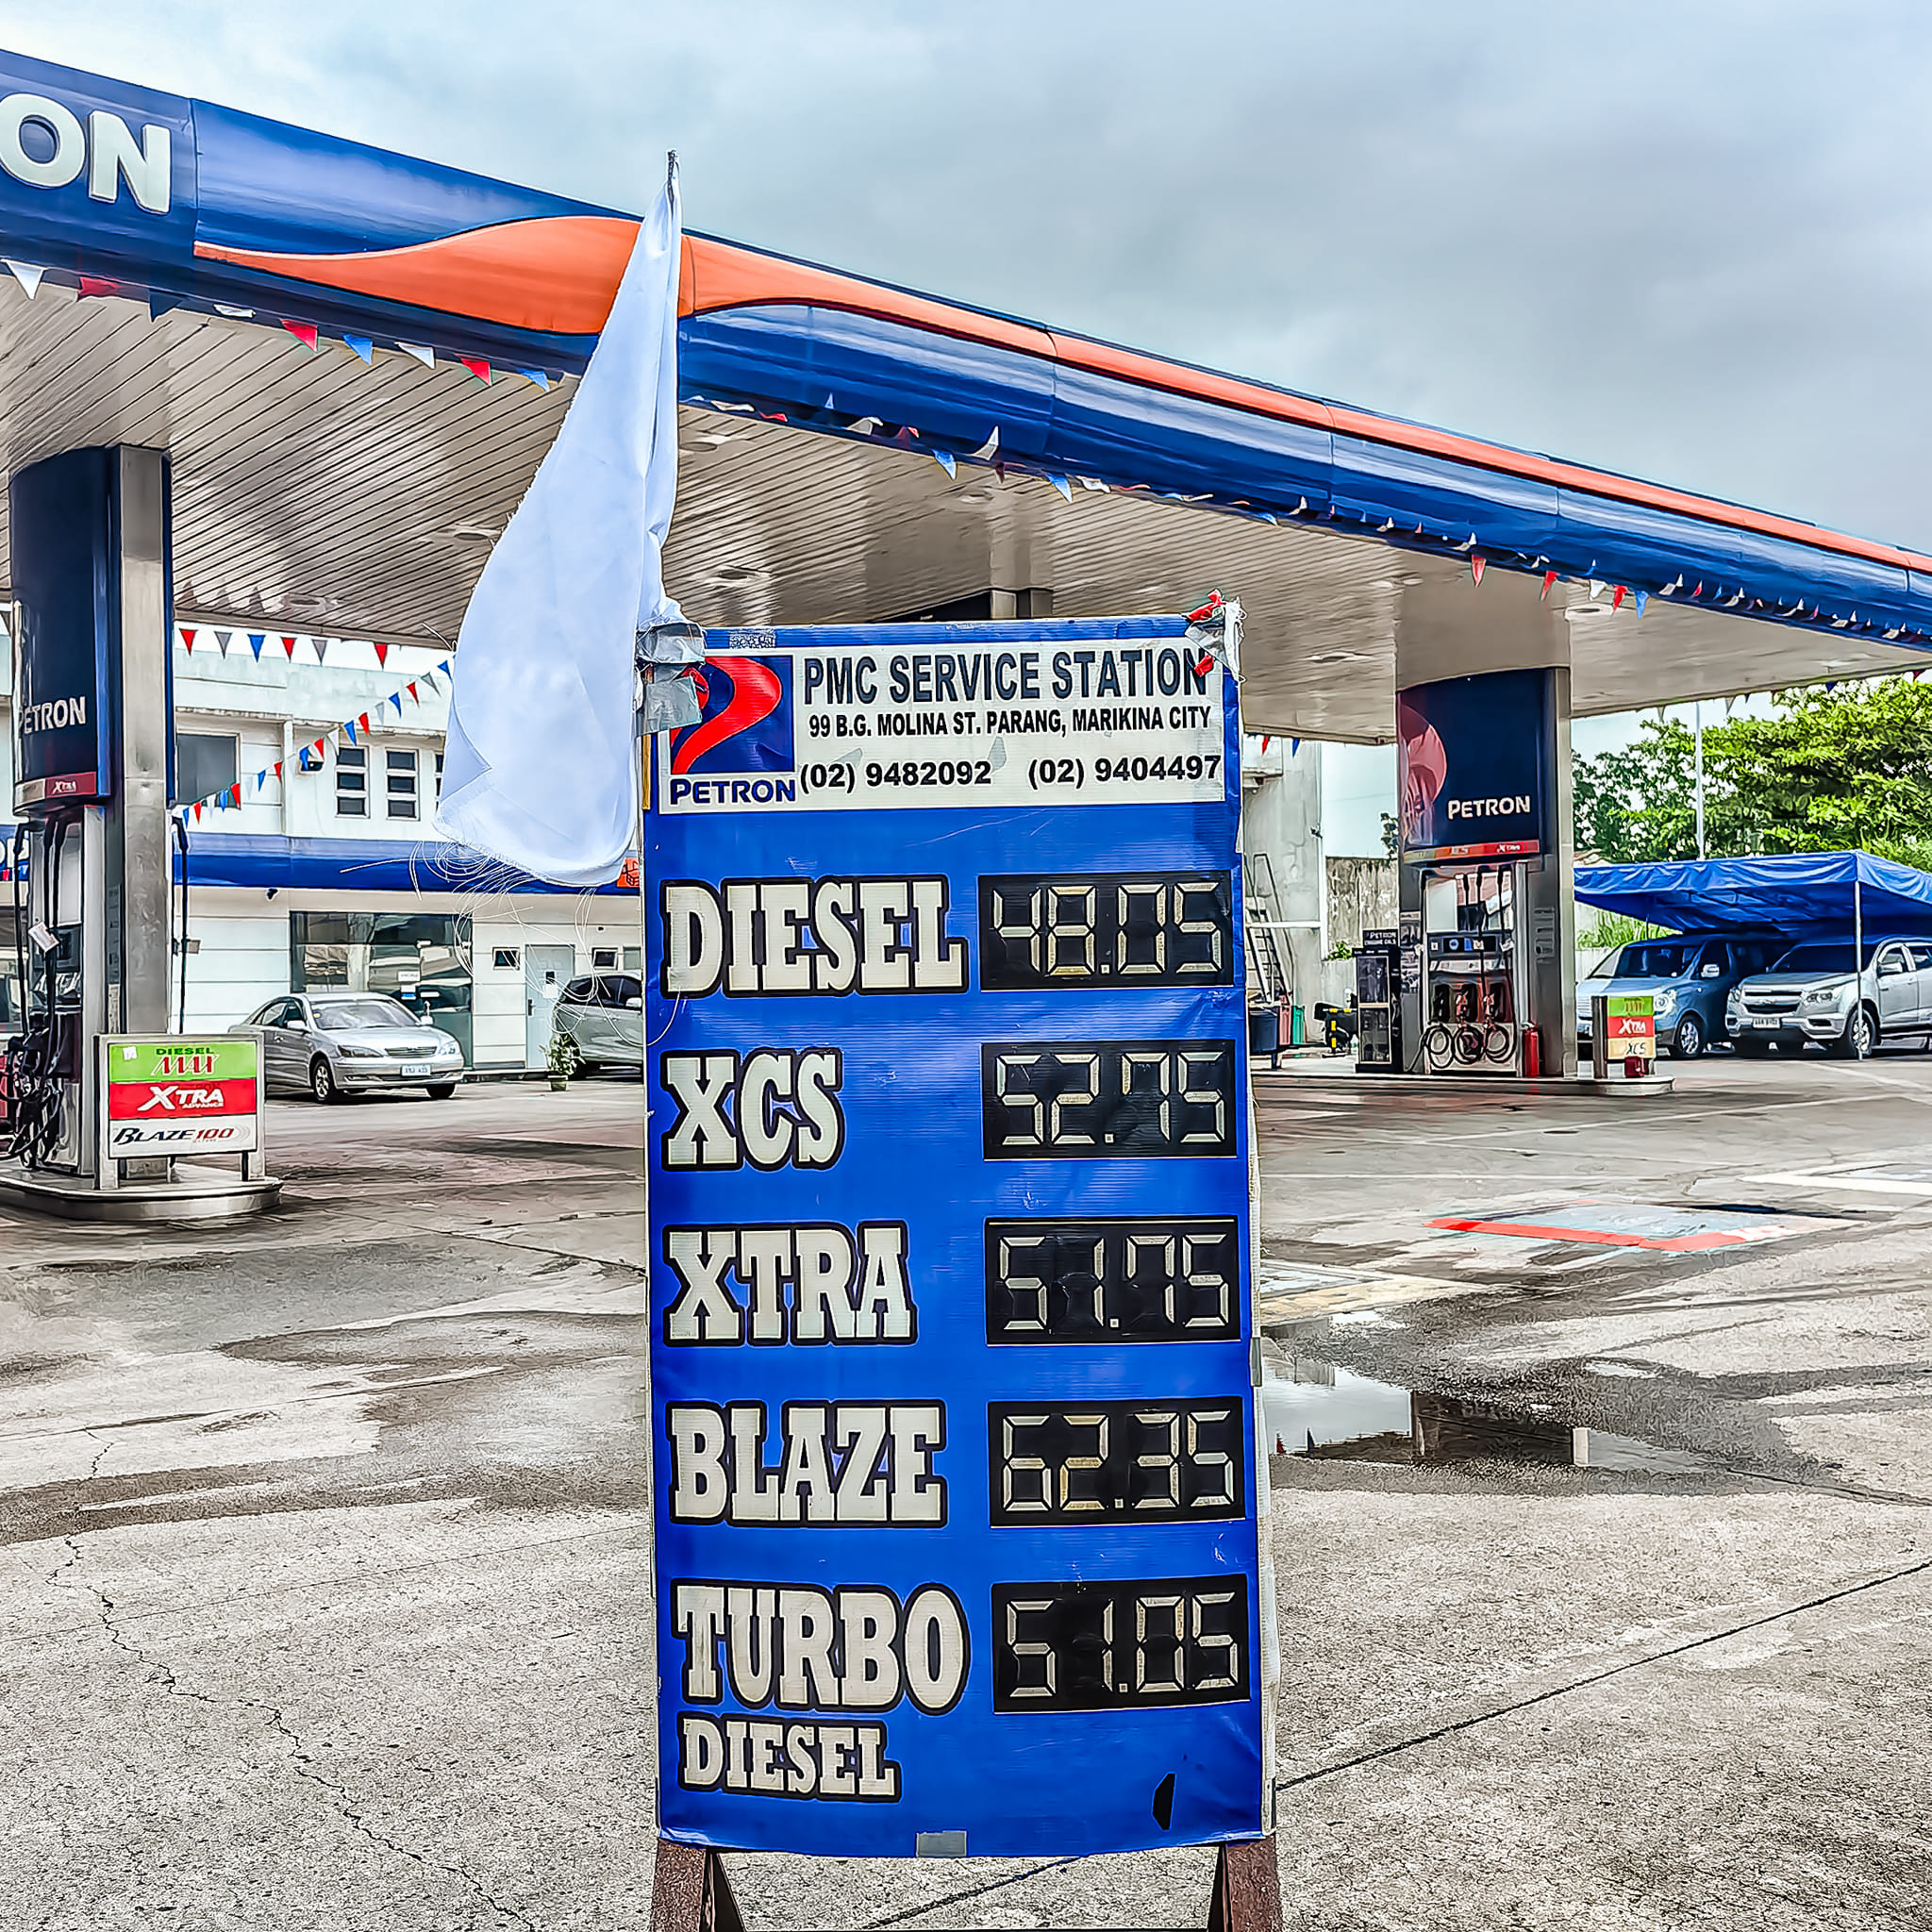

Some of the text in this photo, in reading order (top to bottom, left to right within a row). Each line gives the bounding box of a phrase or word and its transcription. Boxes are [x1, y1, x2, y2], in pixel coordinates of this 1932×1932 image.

[805, 647, 1207, 705] PMC SERVICE STATION
[809, 707, 1211, 737] 99 B.G. MOLINA ST. PARANG, MARIKINA CITY
[670, 779, 796, 804] PETRON
[801, 756, 1222, 794] (02) 9482092 (02) 9404497
[1448, 795, 1531, 820] PETRON
[665, 881, 1224, 993] DIESEL 48.05
[156, 1047, 214, 1056] DIESEL
[1626, 1042, 1645, 1055] XCS
[137, 1086, 224, 1111] XTRA
[666, 1051, 1224, 1165] XCS 52.75
[113, 1127, 234, 1145] BLAZE 100
[669, 1227, 1228, 1340] XTRA 51.75
[672, 1407, 1234, 1523] BLAZE 62.35
[677, 1585, 1238, 1709] TURBO 51.05
[683, 1718, 895, 1797] DIESEL
